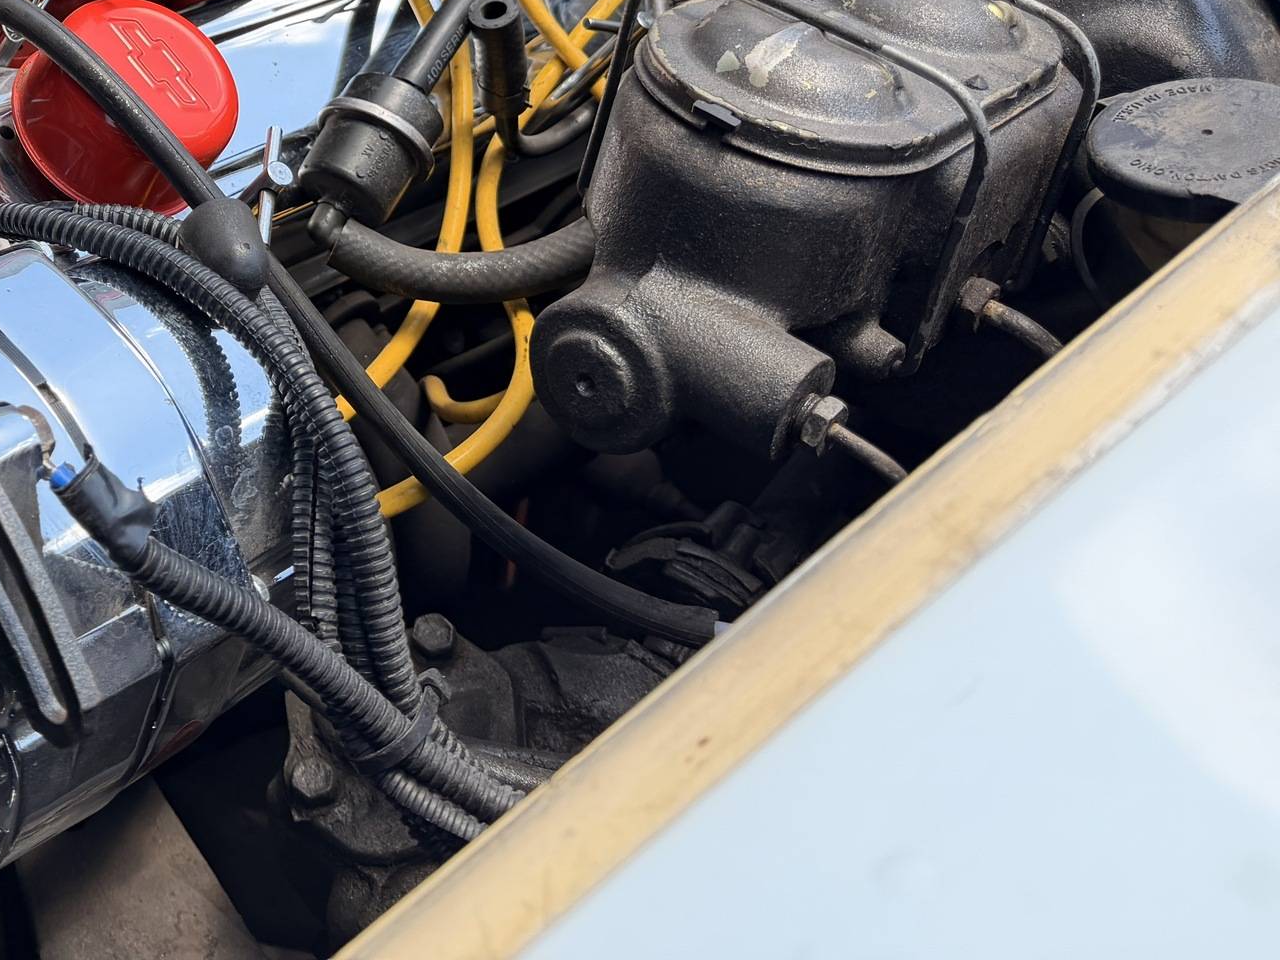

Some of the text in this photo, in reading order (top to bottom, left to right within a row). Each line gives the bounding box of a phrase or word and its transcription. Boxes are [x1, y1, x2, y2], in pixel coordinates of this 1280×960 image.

[1164, 83, 1213, 97] MADE
[1143, 93, 1162, 104] IN
[1129, 159, 1165, 176] OHIO
